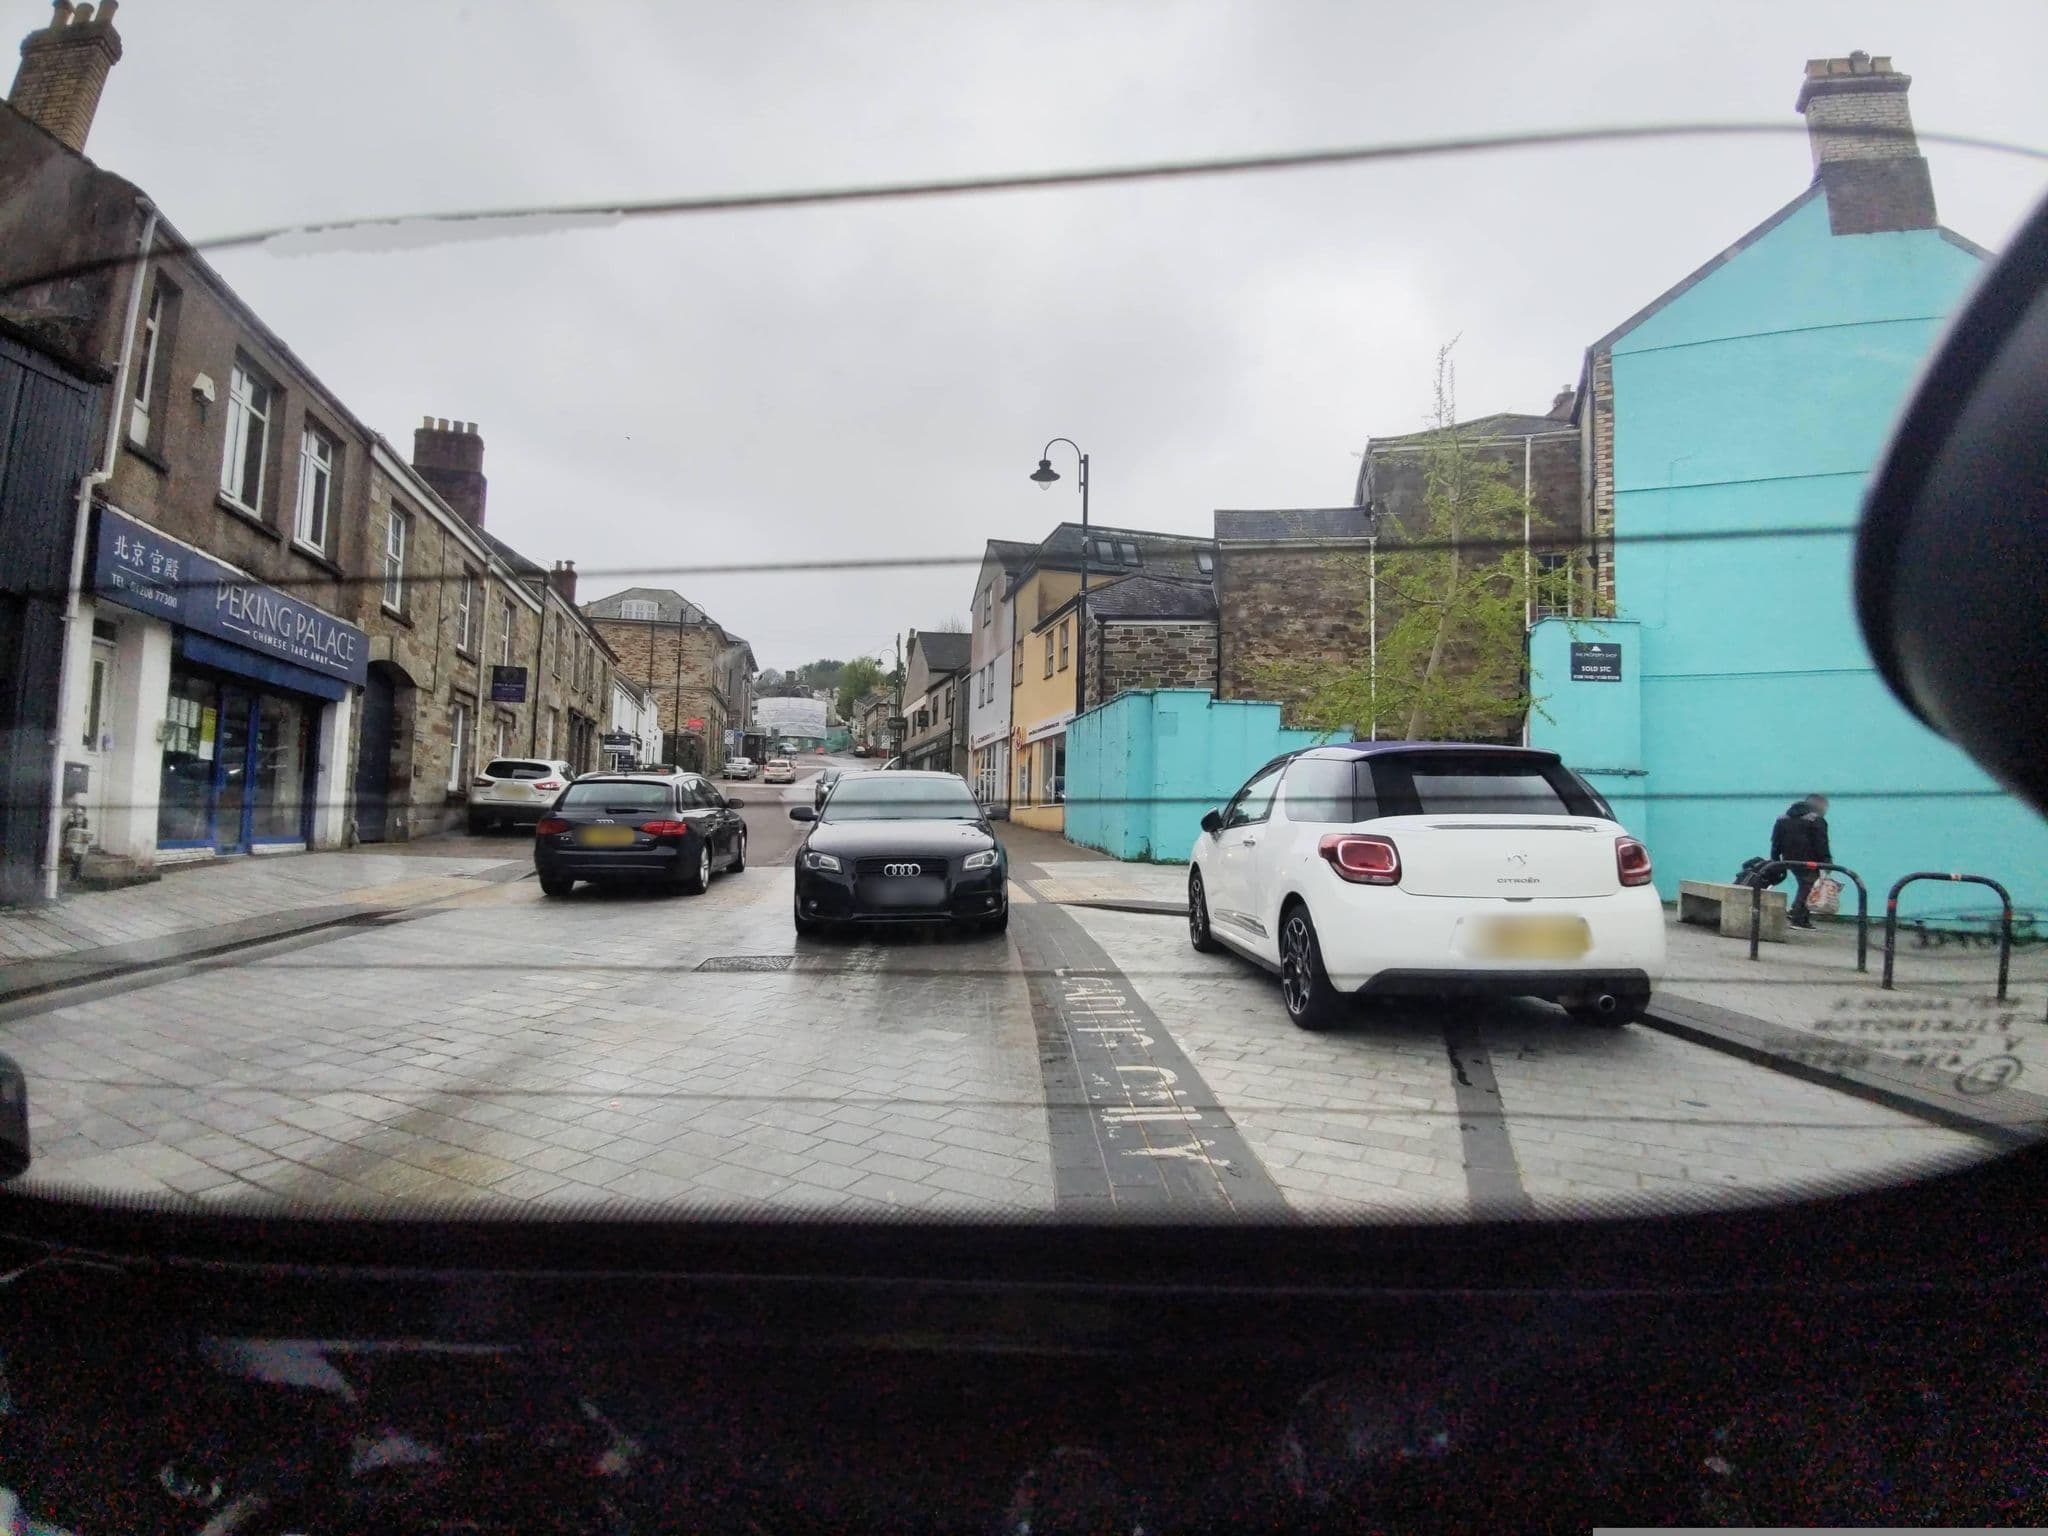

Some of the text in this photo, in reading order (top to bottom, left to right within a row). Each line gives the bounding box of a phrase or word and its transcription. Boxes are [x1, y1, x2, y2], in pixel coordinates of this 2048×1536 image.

[216, 578, 356, 662] PEKING PALACE
[252, 630, 329, 665] CHINESE TAKE AWAY
